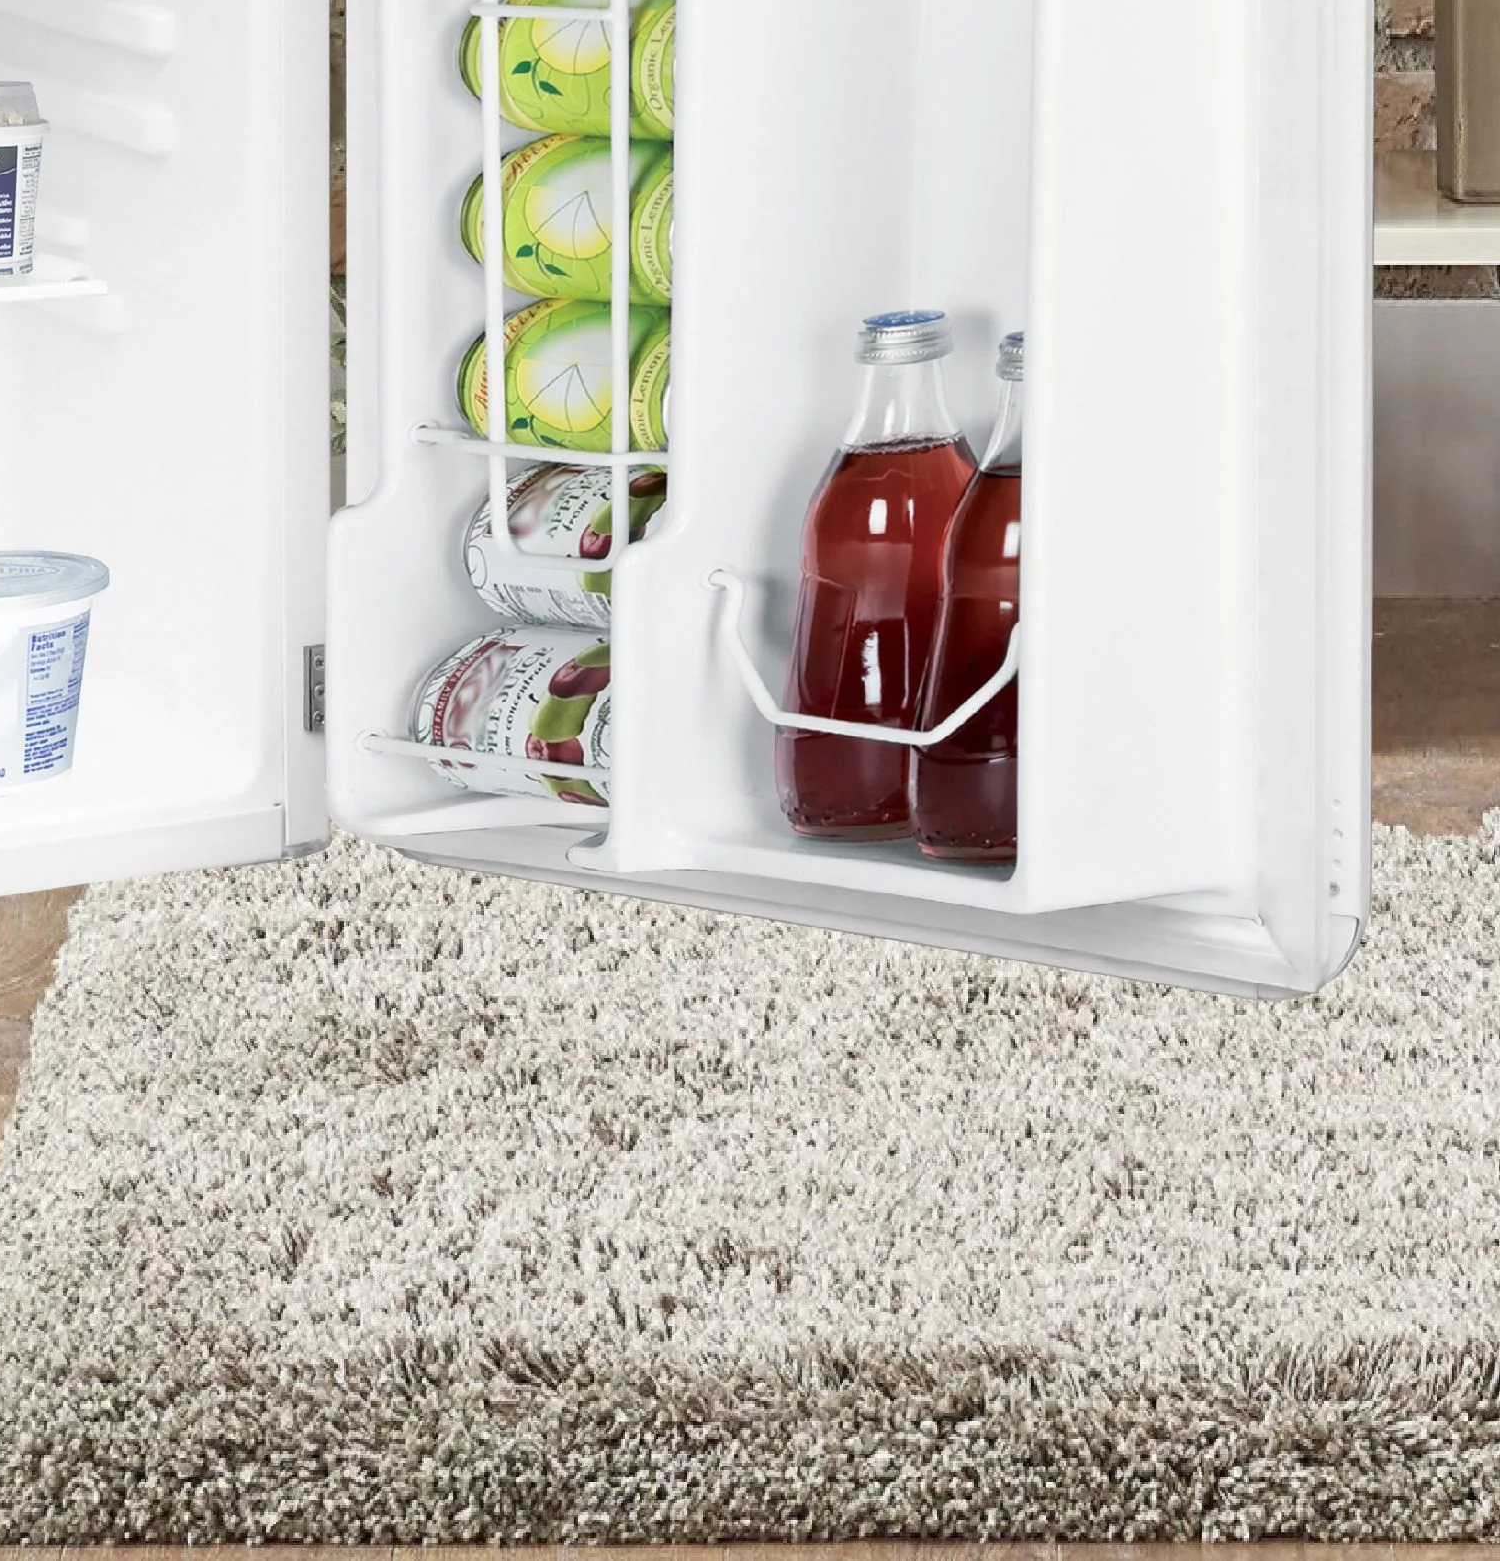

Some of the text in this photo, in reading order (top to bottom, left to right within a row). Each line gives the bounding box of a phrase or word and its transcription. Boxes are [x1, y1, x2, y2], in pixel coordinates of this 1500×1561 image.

[646, 48, 663, 111] Organic
[562, 499, 589, 532] from
[435, 686, 451, 723] FAMILY
[505, 657, 551, 732] concentrate
